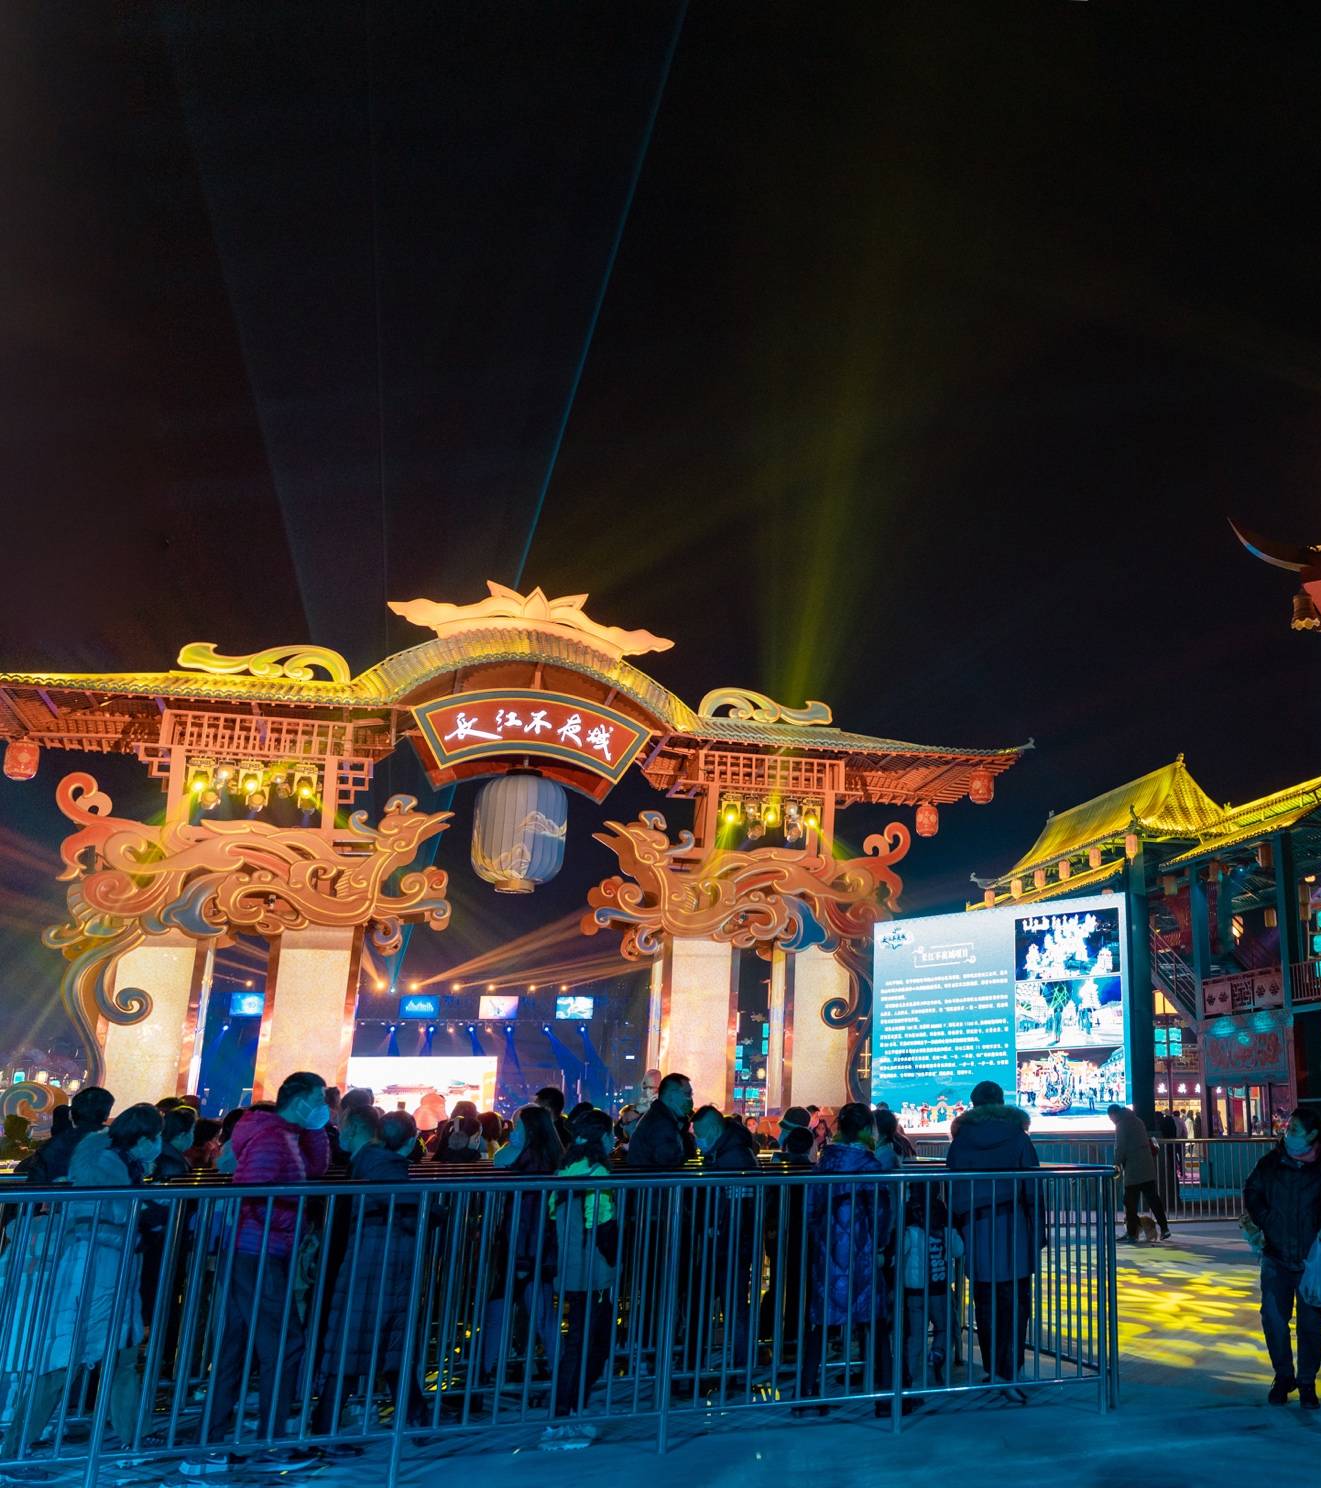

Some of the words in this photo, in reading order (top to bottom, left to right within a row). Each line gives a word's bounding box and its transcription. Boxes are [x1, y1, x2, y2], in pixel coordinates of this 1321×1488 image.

[444, 709, 613, 761] 长江不夜城
